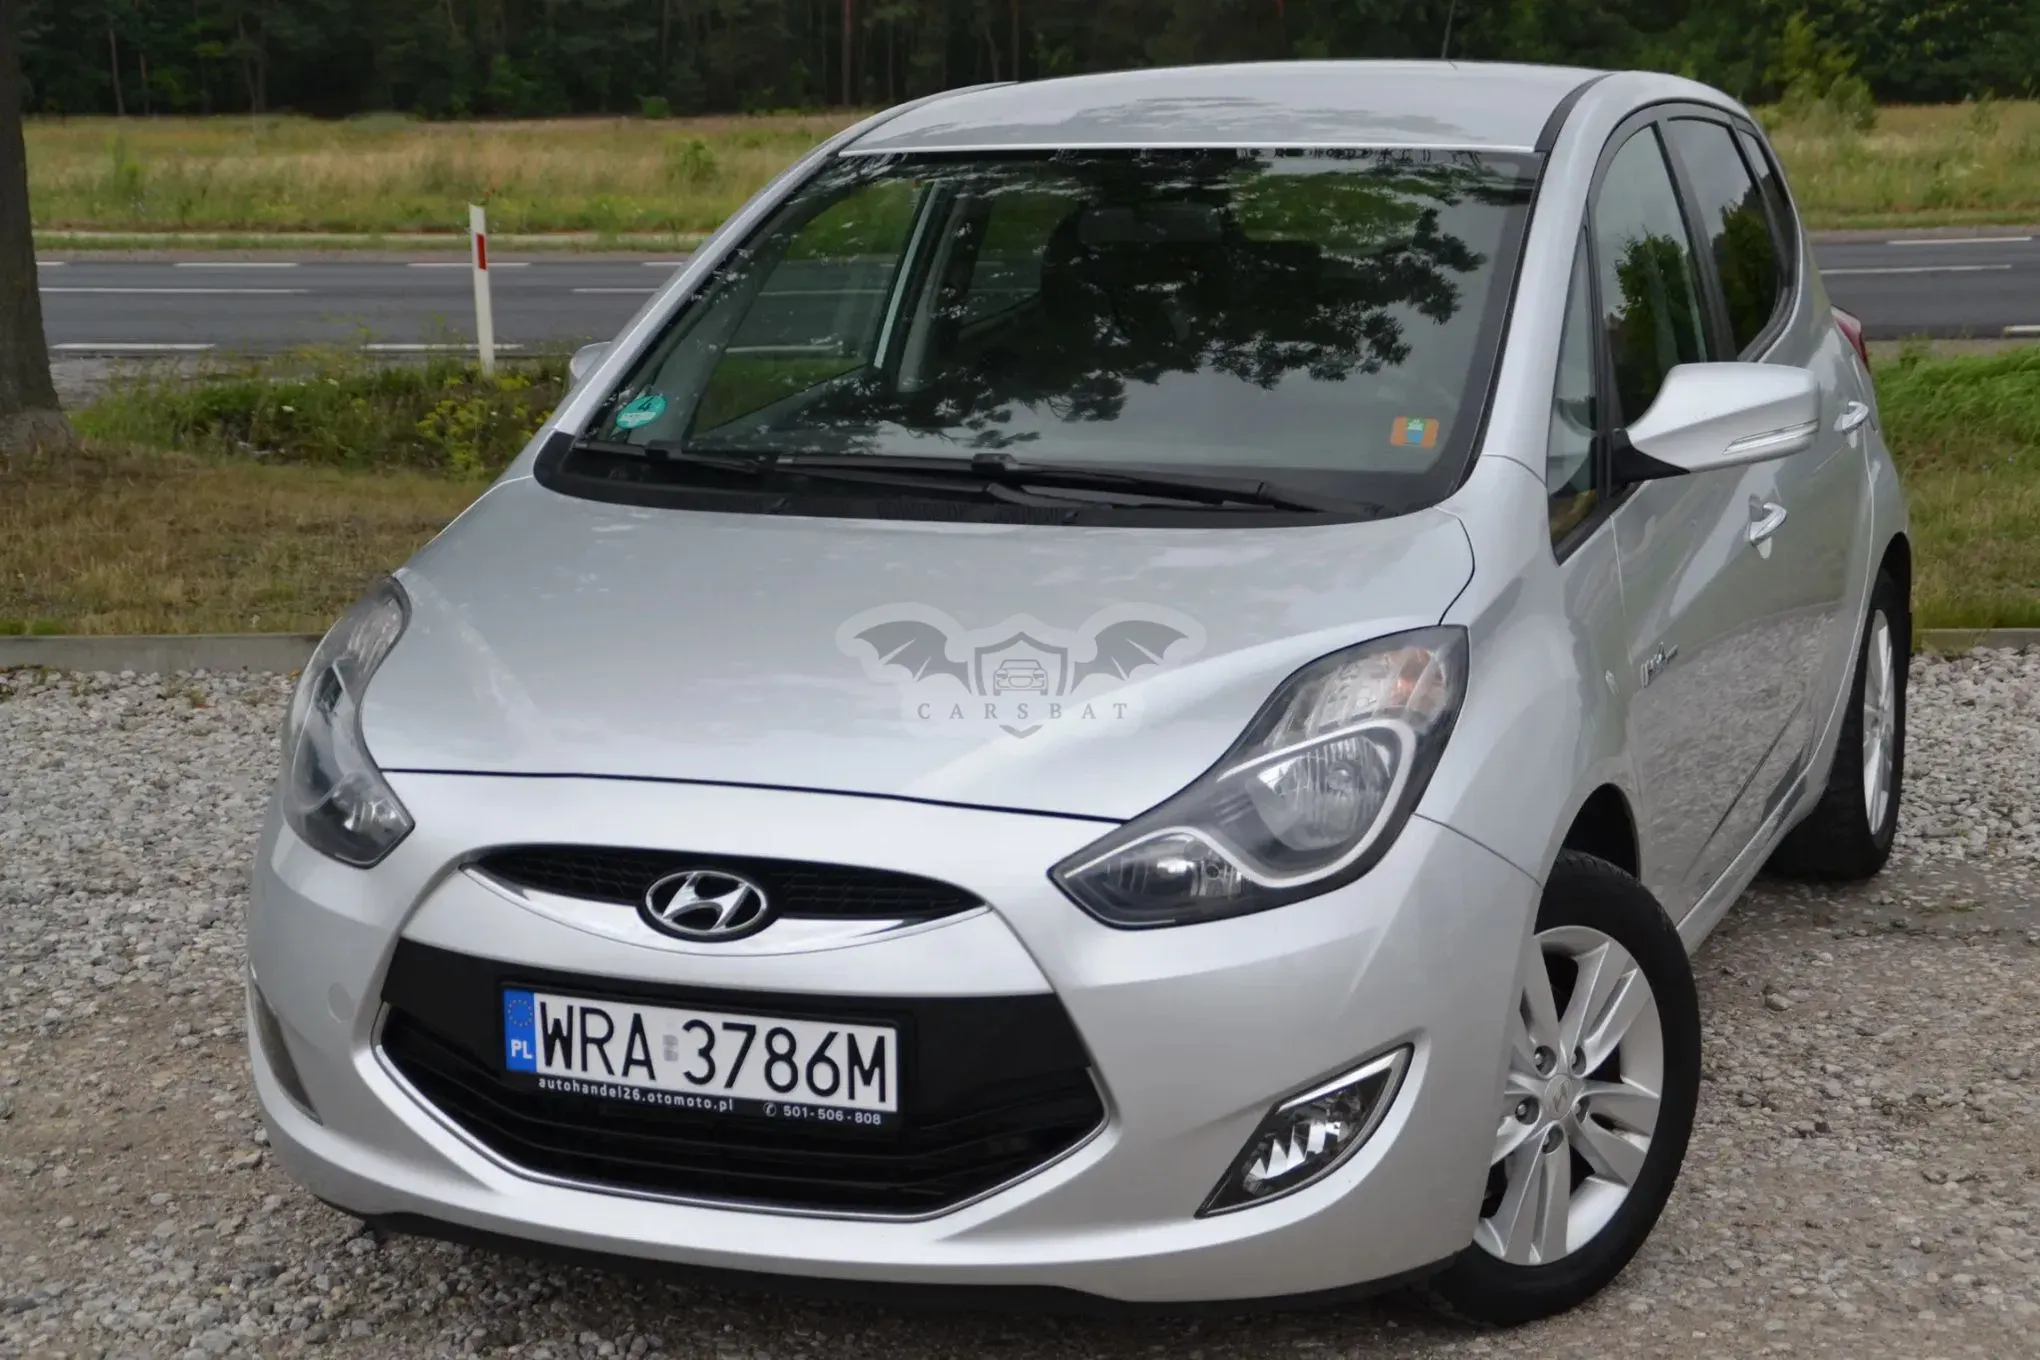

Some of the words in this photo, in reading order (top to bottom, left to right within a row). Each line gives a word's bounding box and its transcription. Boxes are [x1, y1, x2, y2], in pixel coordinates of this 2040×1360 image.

[510, 1038, 533, 1060] PL
[539, 1001, 657, 1081] WRA
[682, 1019, 886, 1104] 3786M
[538, 1077, 734, 1112] autohandel26.otomoto.pl
